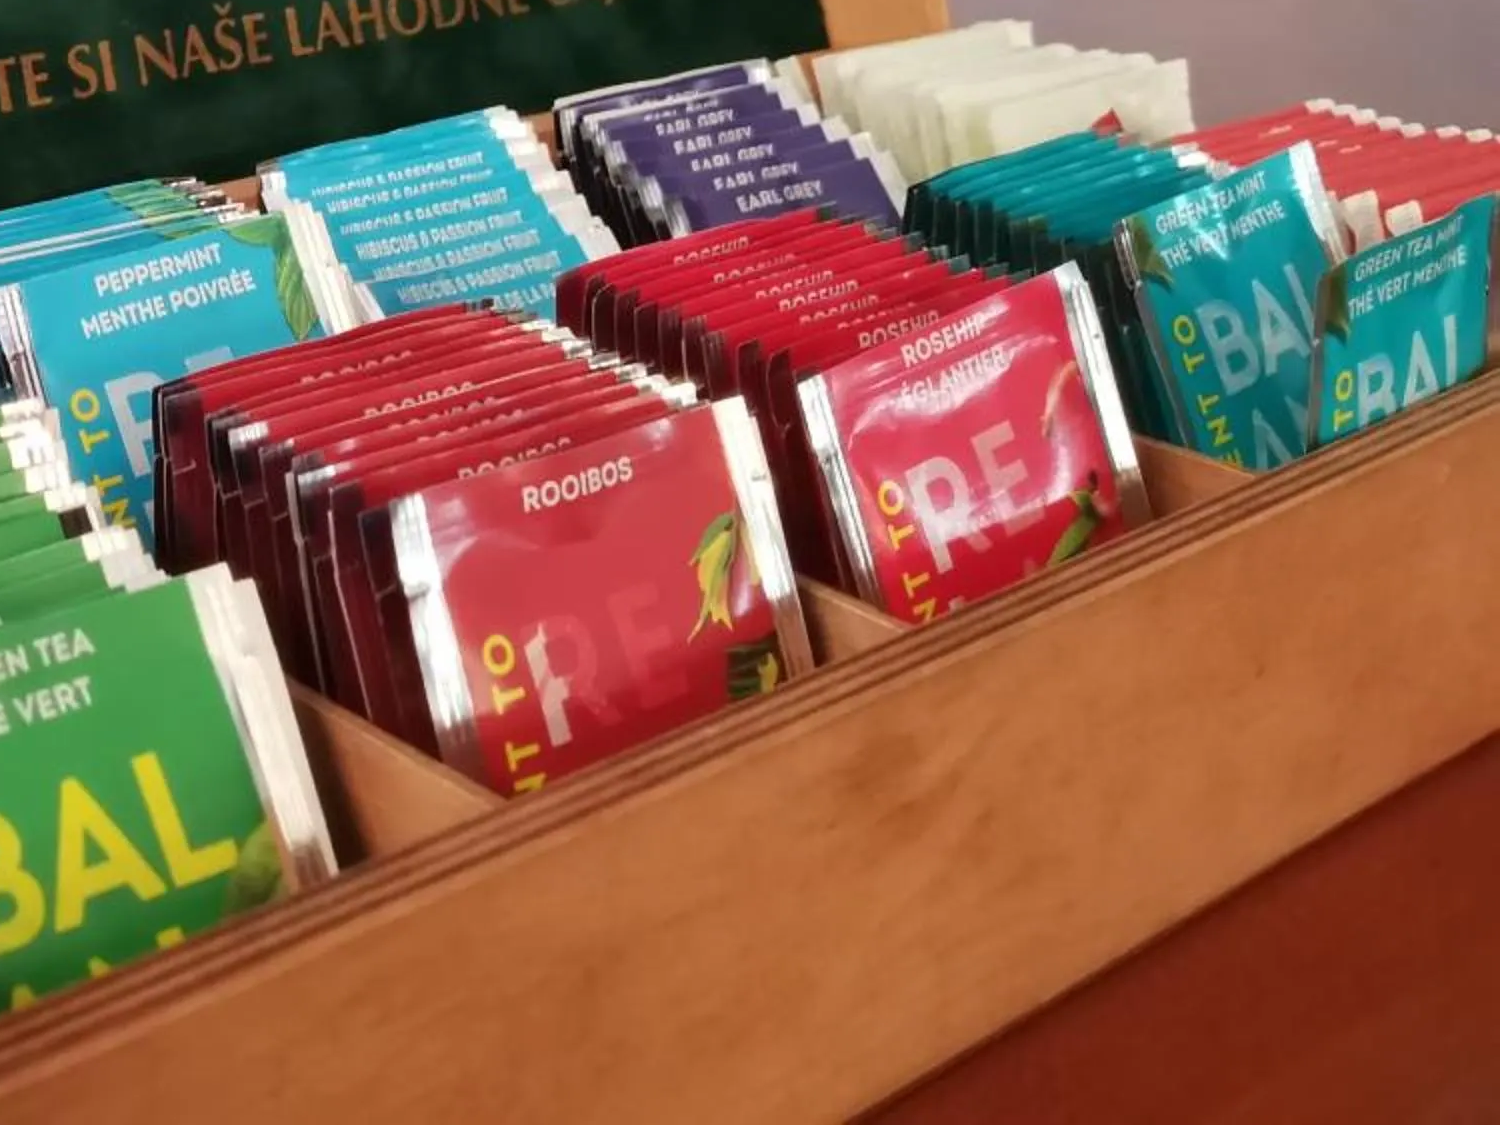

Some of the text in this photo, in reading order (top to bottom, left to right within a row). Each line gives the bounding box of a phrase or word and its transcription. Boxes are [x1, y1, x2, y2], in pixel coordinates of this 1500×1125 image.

[67, 40, 117, 99] SI
[134, 2, 274, 87] NAŠE
[735, 179, 824, 213] EARL GREY
[1155, 171, 1267, 235] GREEN TEA MINT
[1160, 237, 1192, 271] THÉ
[1231, 200, 1286, 240] MENTHE
[1355, 215, 1465, 282] GREEN TEA MINT
[94, 242, 222, 298] PEPPERMINT
[1348, 244, 1468, 320] THÉ VERT MENTHE
[80, 268, 256, 339] MENTHE POIVRÉE
[901, 310, 989, 368] ROSEHIP
[901, 346, 1007, 405] ÉGLANTIER
[69, 388, 110, 454] TO
[521, 455, 635, 513] ROOIBOS
[877, 478, 916, 552] TO
[34, 627, 96, 669] TEA
[482, 633, 527, 716] TO
[13, 675, 94, 726] VERT
